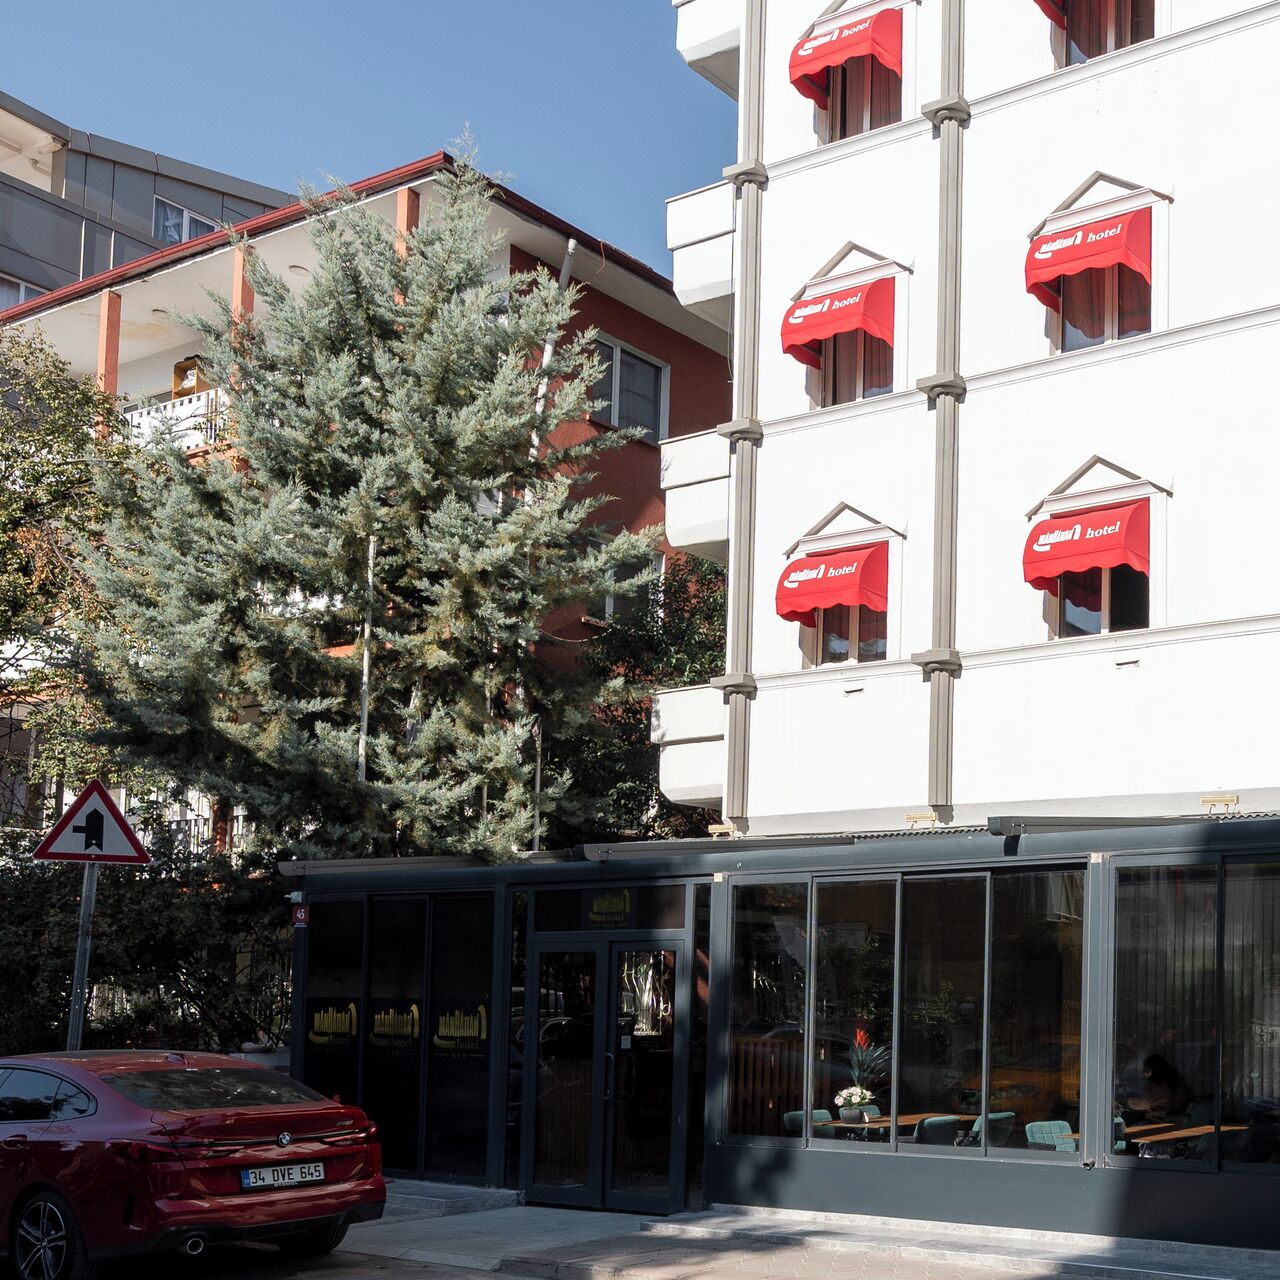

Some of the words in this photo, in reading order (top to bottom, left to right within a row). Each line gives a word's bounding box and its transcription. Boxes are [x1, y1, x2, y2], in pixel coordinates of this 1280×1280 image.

[1086, 223, 1123, 243] hotel
[832, 293, 862, 310] hotel
[1085, 521, 1120, 539] hotel
[827, 562, 857, 578] hotel
[296, 908, 305, 920] 45
[250, 1171, 265, 1185] 34
[272, 1167, 294, 1181] DVE
[300, 1165, 321, 1178] 645
